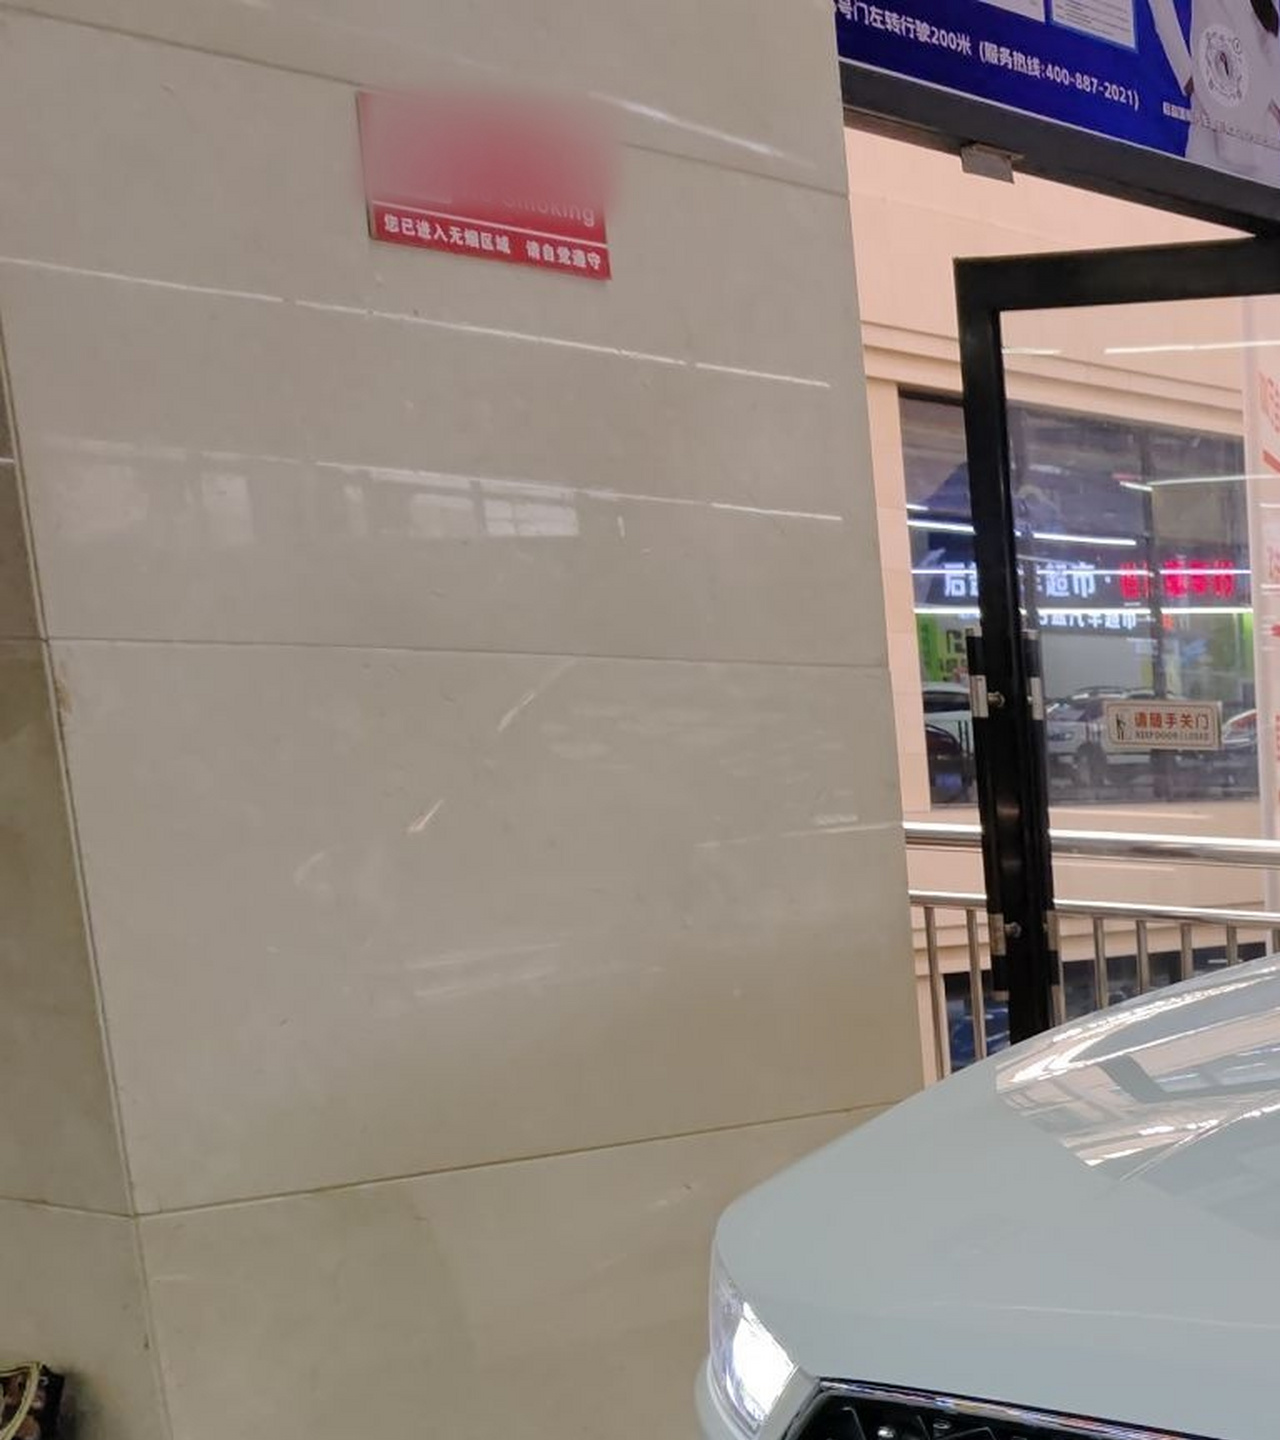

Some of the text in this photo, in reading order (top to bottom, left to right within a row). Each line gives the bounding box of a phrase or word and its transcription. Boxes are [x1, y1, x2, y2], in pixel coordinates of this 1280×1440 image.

[1134, 711, 1209, 730] 请随手关门
